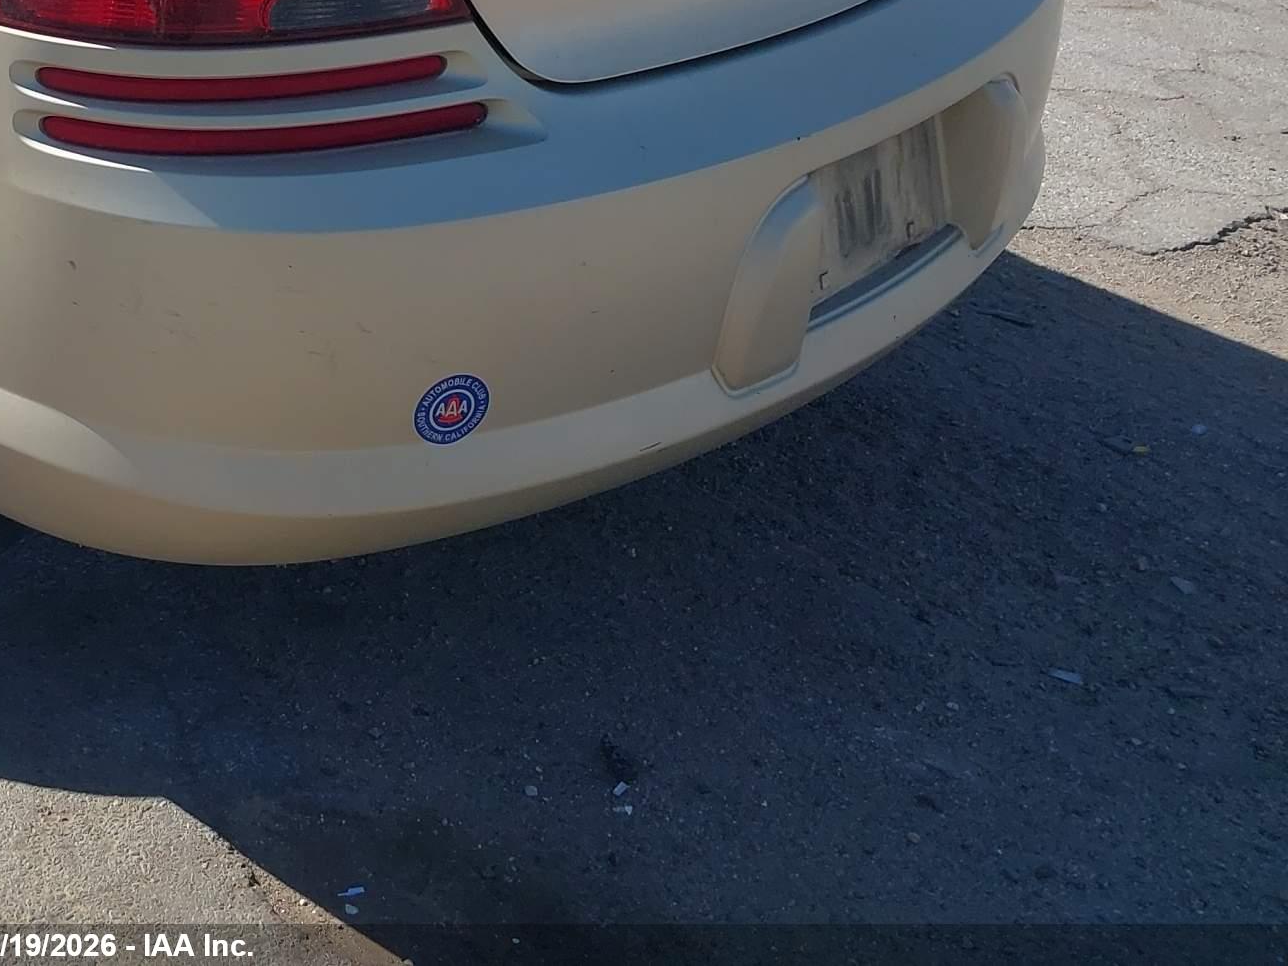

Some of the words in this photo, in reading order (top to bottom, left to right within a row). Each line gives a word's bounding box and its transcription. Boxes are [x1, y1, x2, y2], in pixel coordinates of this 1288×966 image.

[422, 377, 473, 407] AUTOMOBILE
[471, 381, 487, 400] CLUB
[435, 399, 468, 417] AAA
[417, 412, 444, 442] SOUTHERN
[444, 405, 486, 442] CALIFORNIA
